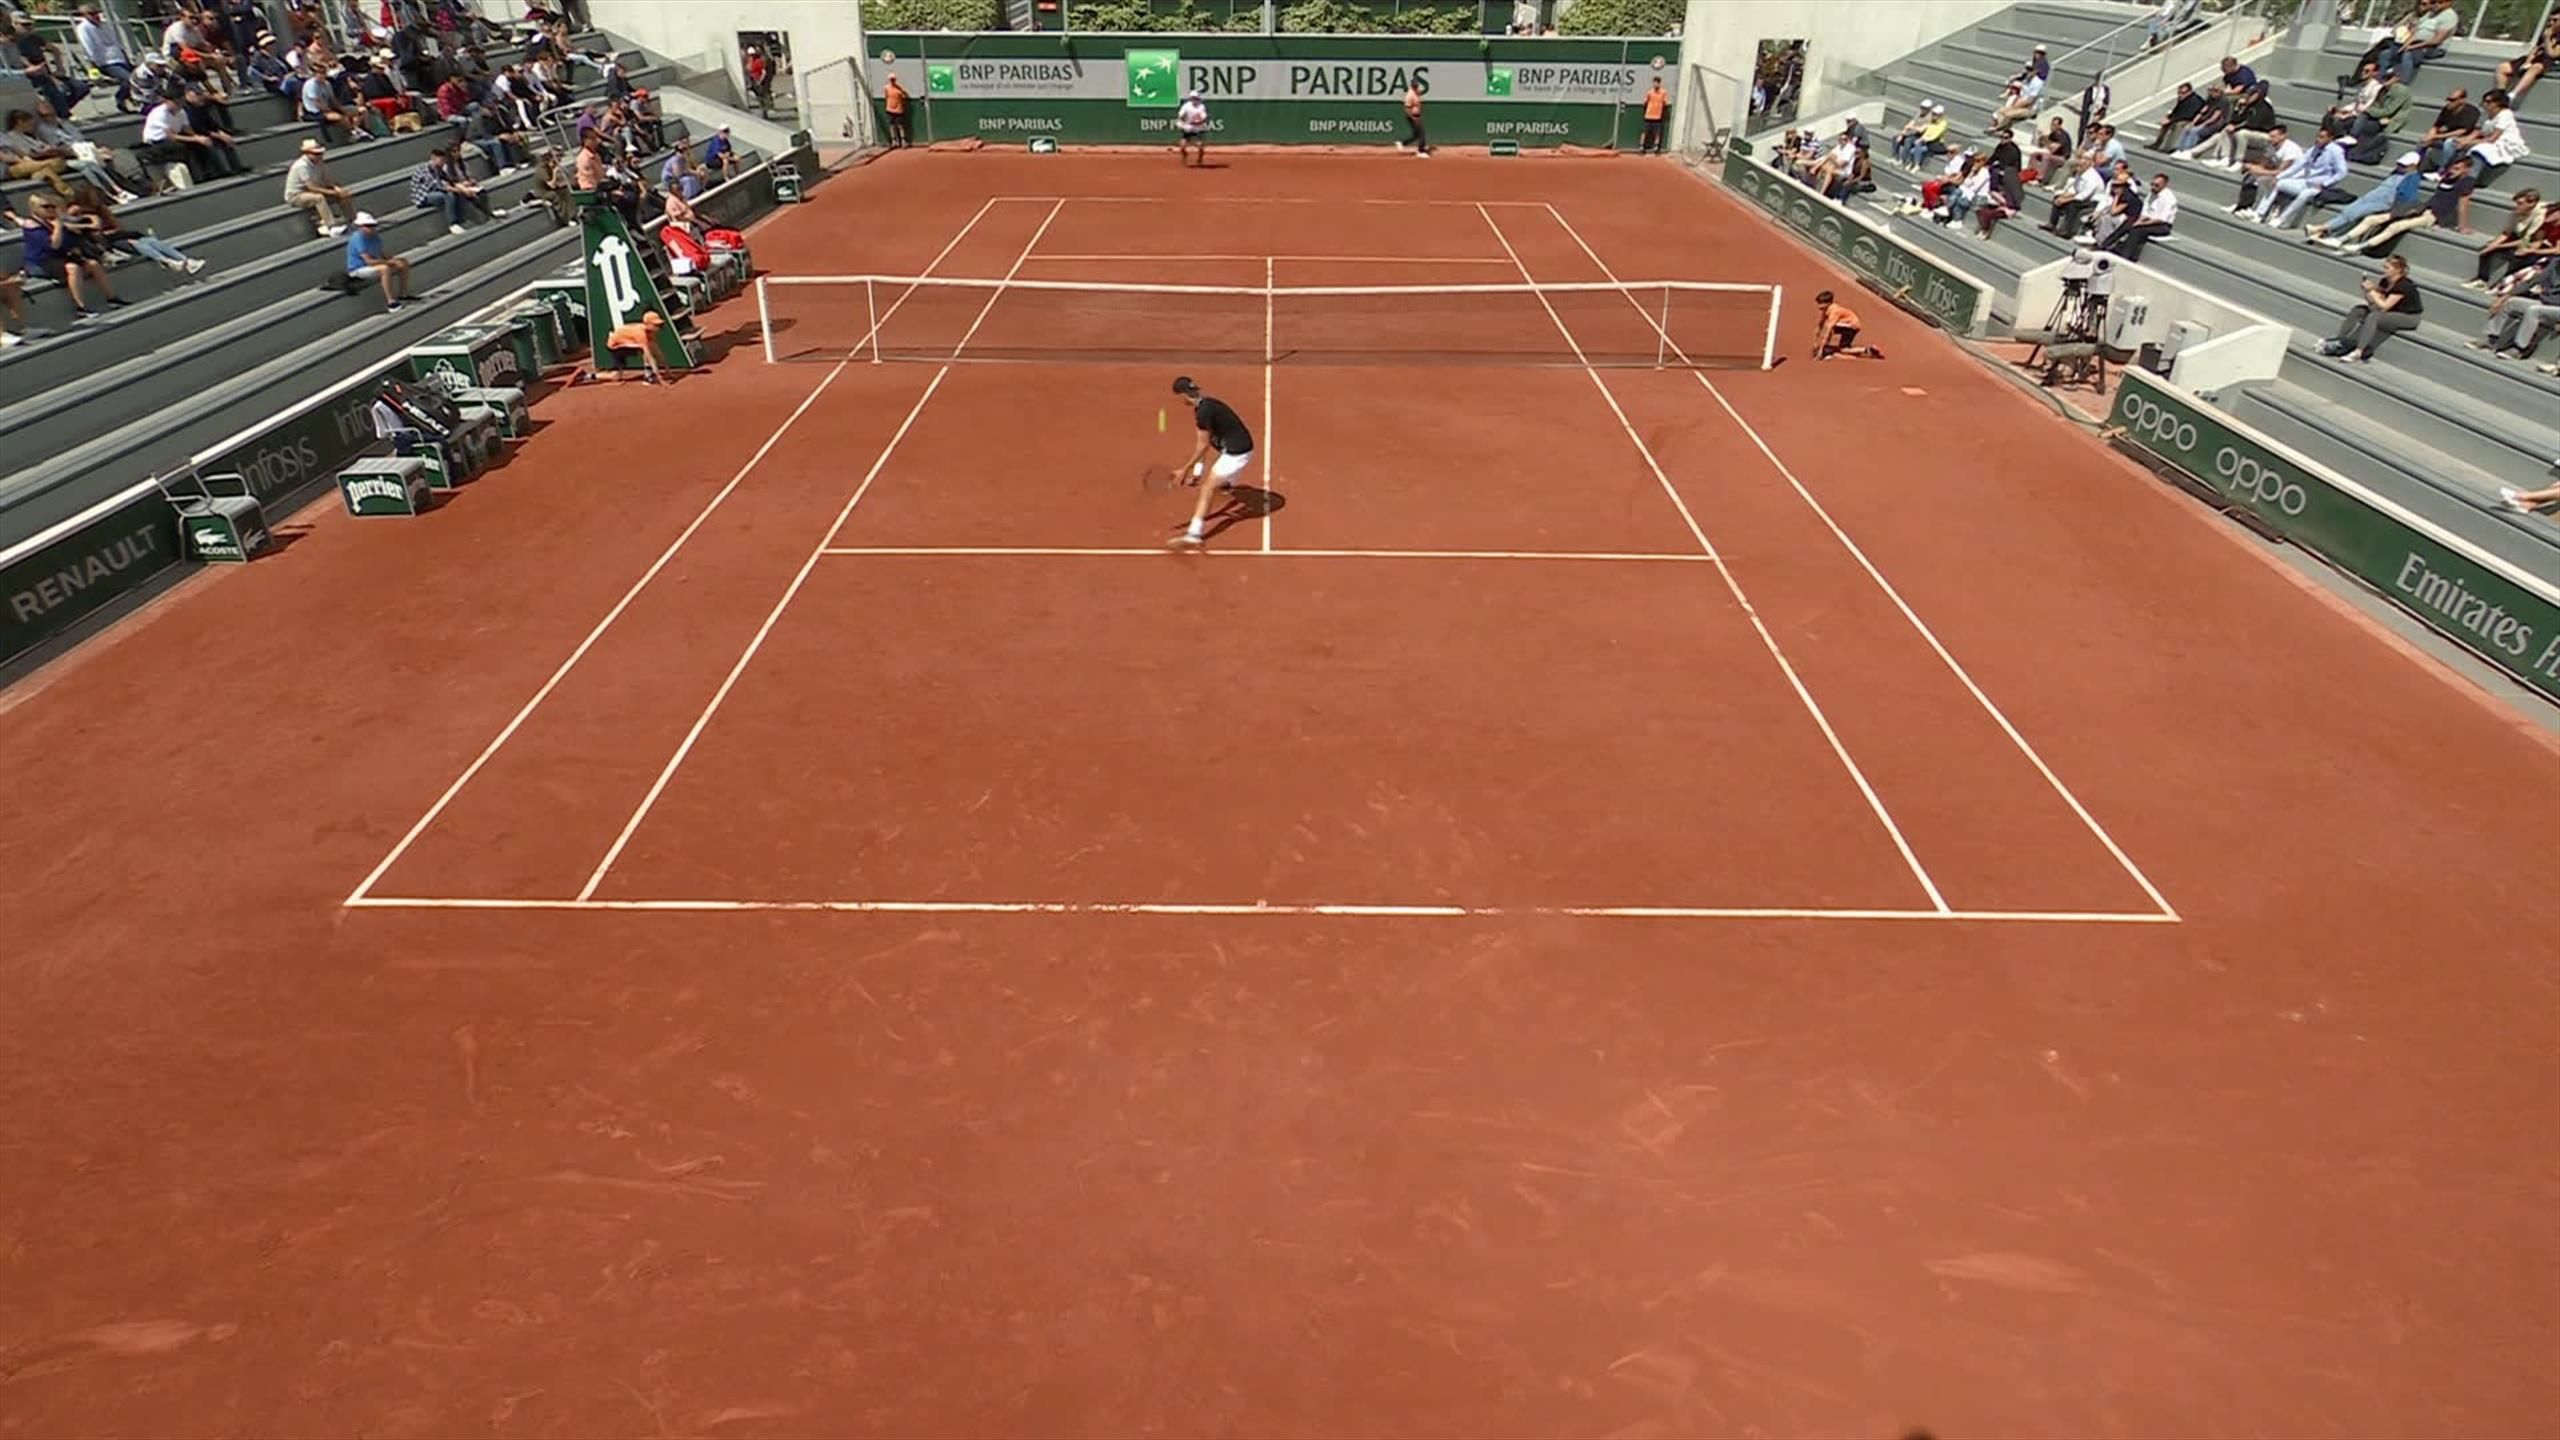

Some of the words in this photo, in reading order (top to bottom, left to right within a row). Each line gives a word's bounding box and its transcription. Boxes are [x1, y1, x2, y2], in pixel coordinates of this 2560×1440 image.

[959, 64, 995, 80] BNP
[1000, 64, 1073, 81] PARIBAS
[1188, 66, 1257, 95] BNP
[1290, 66, 1430, 95] PARIBAS
[1517, 68, 1555, 84] BNP
[1559, 68, 1636, 86] PARIBAS
[978, 118, 1006, 130] BNP
[1008, 118, 1063, 130] PARIBAS
[1140, 119, 1167, 131] BNP
[1309, 120, 1336, 132] BNP
[1338, 120, 1394, 132] PARIBAS
[1486, 122, 1514, 134] BNP
[1515, 122, 1569, 134] PARIBAS
[2122, 393, 2198, 452] oppo
[236, 437, 319, 498] Infosys
[2215, 446, 2307, 517] oppo
[10, 523, 156, 624] RENAULT
[2396, 552, 2534, 657] Emirates
